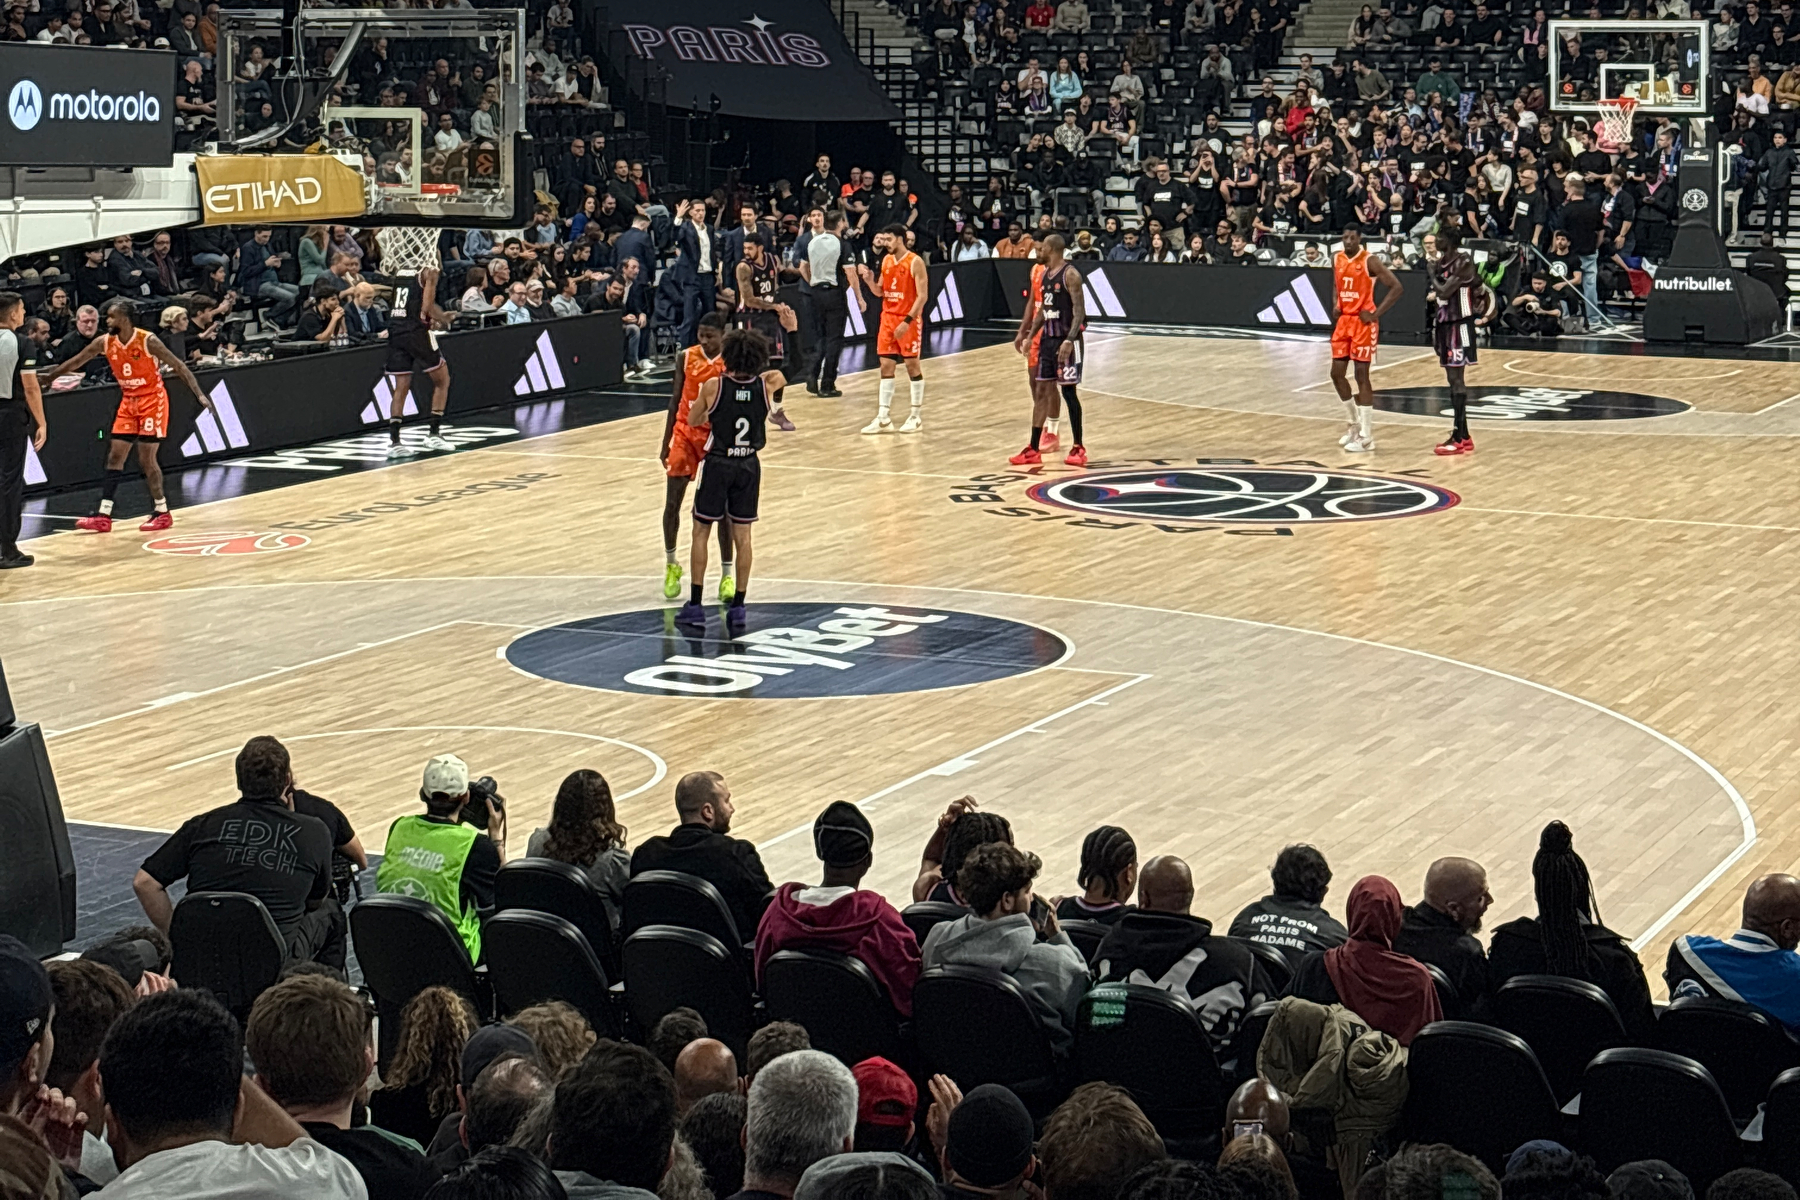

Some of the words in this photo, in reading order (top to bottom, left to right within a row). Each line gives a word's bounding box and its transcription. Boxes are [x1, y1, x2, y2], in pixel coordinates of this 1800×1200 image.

[622, 22, 832, 68] PARIS
[50, 91, 160, 122] motorola
[205, 176, 322, 214] ETIHAD
[759, 281, 771, 294] 20
[891, 278, 897, 290] 2
[1343, 277, 1354, 290] 77
[394, 287, 409, 308] 13
[1044, 293, 1053, 306] 22
[1357, 347, 1370, 358] 77
[1453, 349, 1463, 361] 15
[122, 363, 132, 376] 8
[1063, 367, 1077, 380] 22
[736, 390, 751, 401] HIFI
[144, 418, 154, 431] 8
[735, 417, 750, 446] 2
[269, 470, 562, 531] EuroLeague
[624, 607, 949, 693] OlyBet
[218, 819, 302, 853] EDK
[225, 844, 298, 875] TECH
[1251, 913, 1278, 924] NOT
[1260, 924, 1300, 936] PARIS
